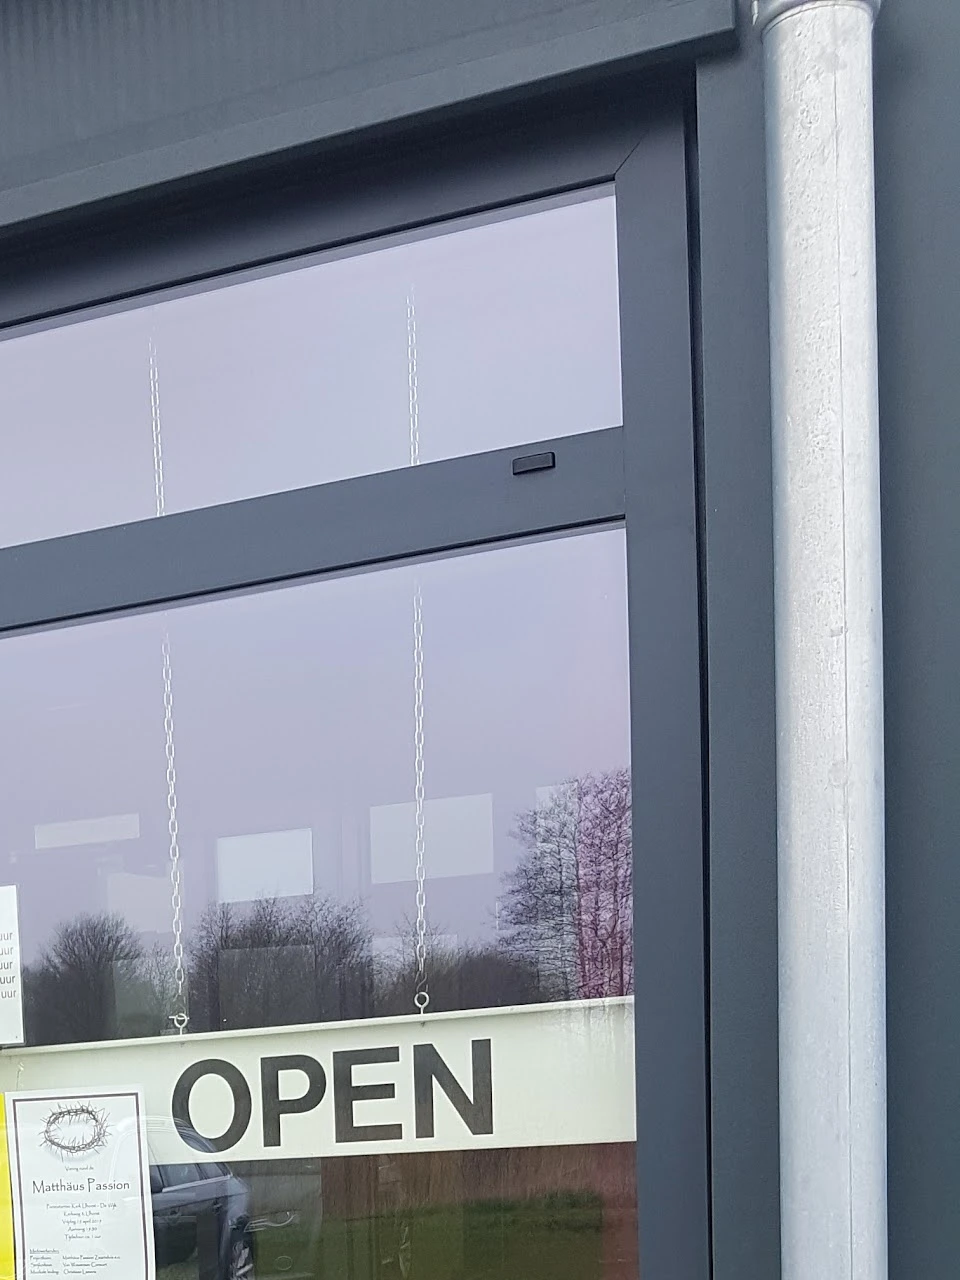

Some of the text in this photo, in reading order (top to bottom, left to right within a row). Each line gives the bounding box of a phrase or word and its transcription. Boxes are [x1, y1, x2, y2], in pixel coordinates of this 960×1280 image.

[0, 975, 15, 984] uur
[1, 990, 17, 999] uur
[172, 1038, 494, 1154] OPEN
[33, 1178, 129, 1194] Matthäus Passion
